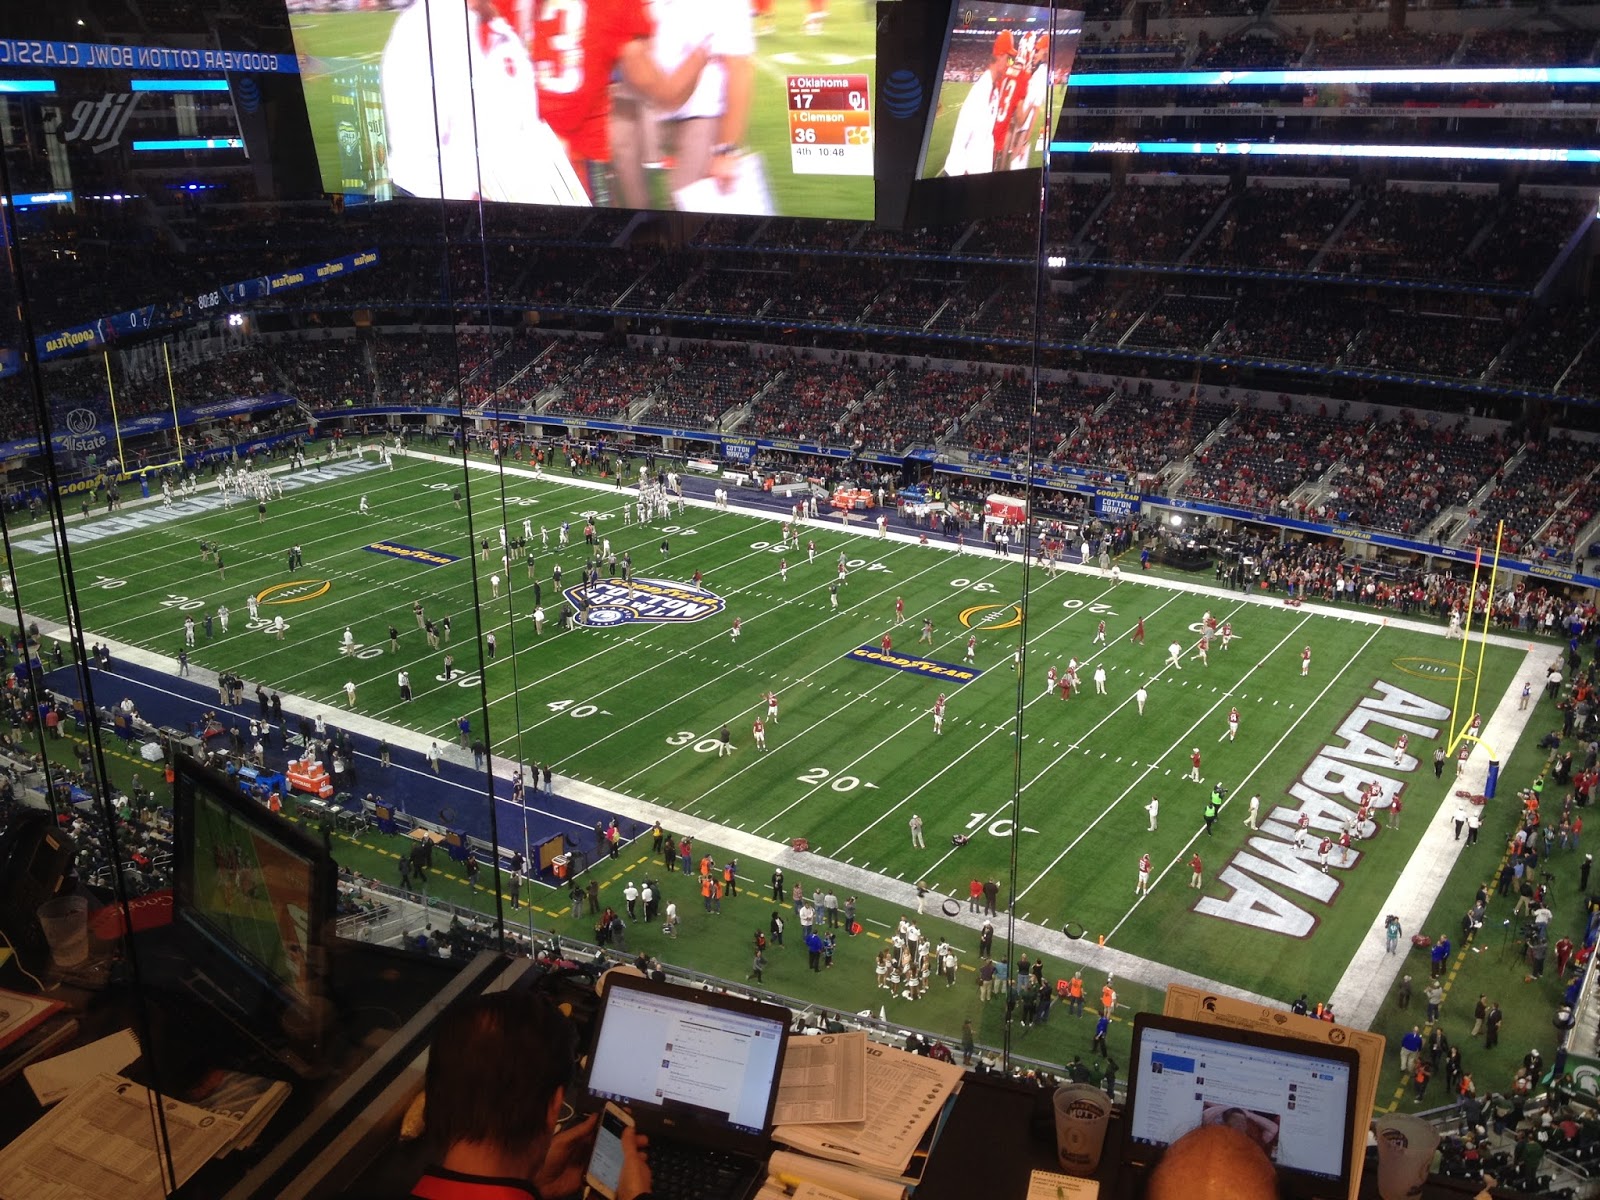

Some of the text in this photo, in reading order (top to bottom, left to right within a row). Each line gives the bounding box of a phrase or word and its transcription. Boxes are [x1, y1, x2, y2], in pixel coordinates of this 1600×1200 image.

[790, 77, 849, 88] 4 Oklahoma
[793, 94, 814, 109] 17
[793, 112, 845, 122] 1 Clemson
[795, 128, 816, 143] 36
[796, 147, 845, 157] 4th 10:48
[62, 435, 107, 451] Allstate
[720, 436, 757, 447] GOODYEAR
[726, 444, 751, 453] COTTON
[772, 442, 800, 450] GOODYEAR
[961, 467, 992, 476] GOODYEAR
[1045, 480, 1078, 490] GOODYEAR
[1096, 489, 1140, 501] GOODYEAR
[1102, 498, 1132, 508] COTTON
[1101, 506, 1124, 515] BOWL
[1331, 528, 1372, 540] GOODYEAR
[370, 542, 453, 565] GOODYEAR
[1529, 565, 1574, 579] GOODYEAR
[610, 579, 719, 605] GOODYEAR
[580, 584, 711, 617] COTTON
[591, 594, 667, 617] BOWL
[853, 649, 975, 680] GOODYEAR
[546, 699, 598, 718] 40
[665, 731, 720, 753] 30
[796, 767, 860, 792] 20
[1191, 678, 1453, 939] ALABAMA
[965, 811, 1018, 837] 10
